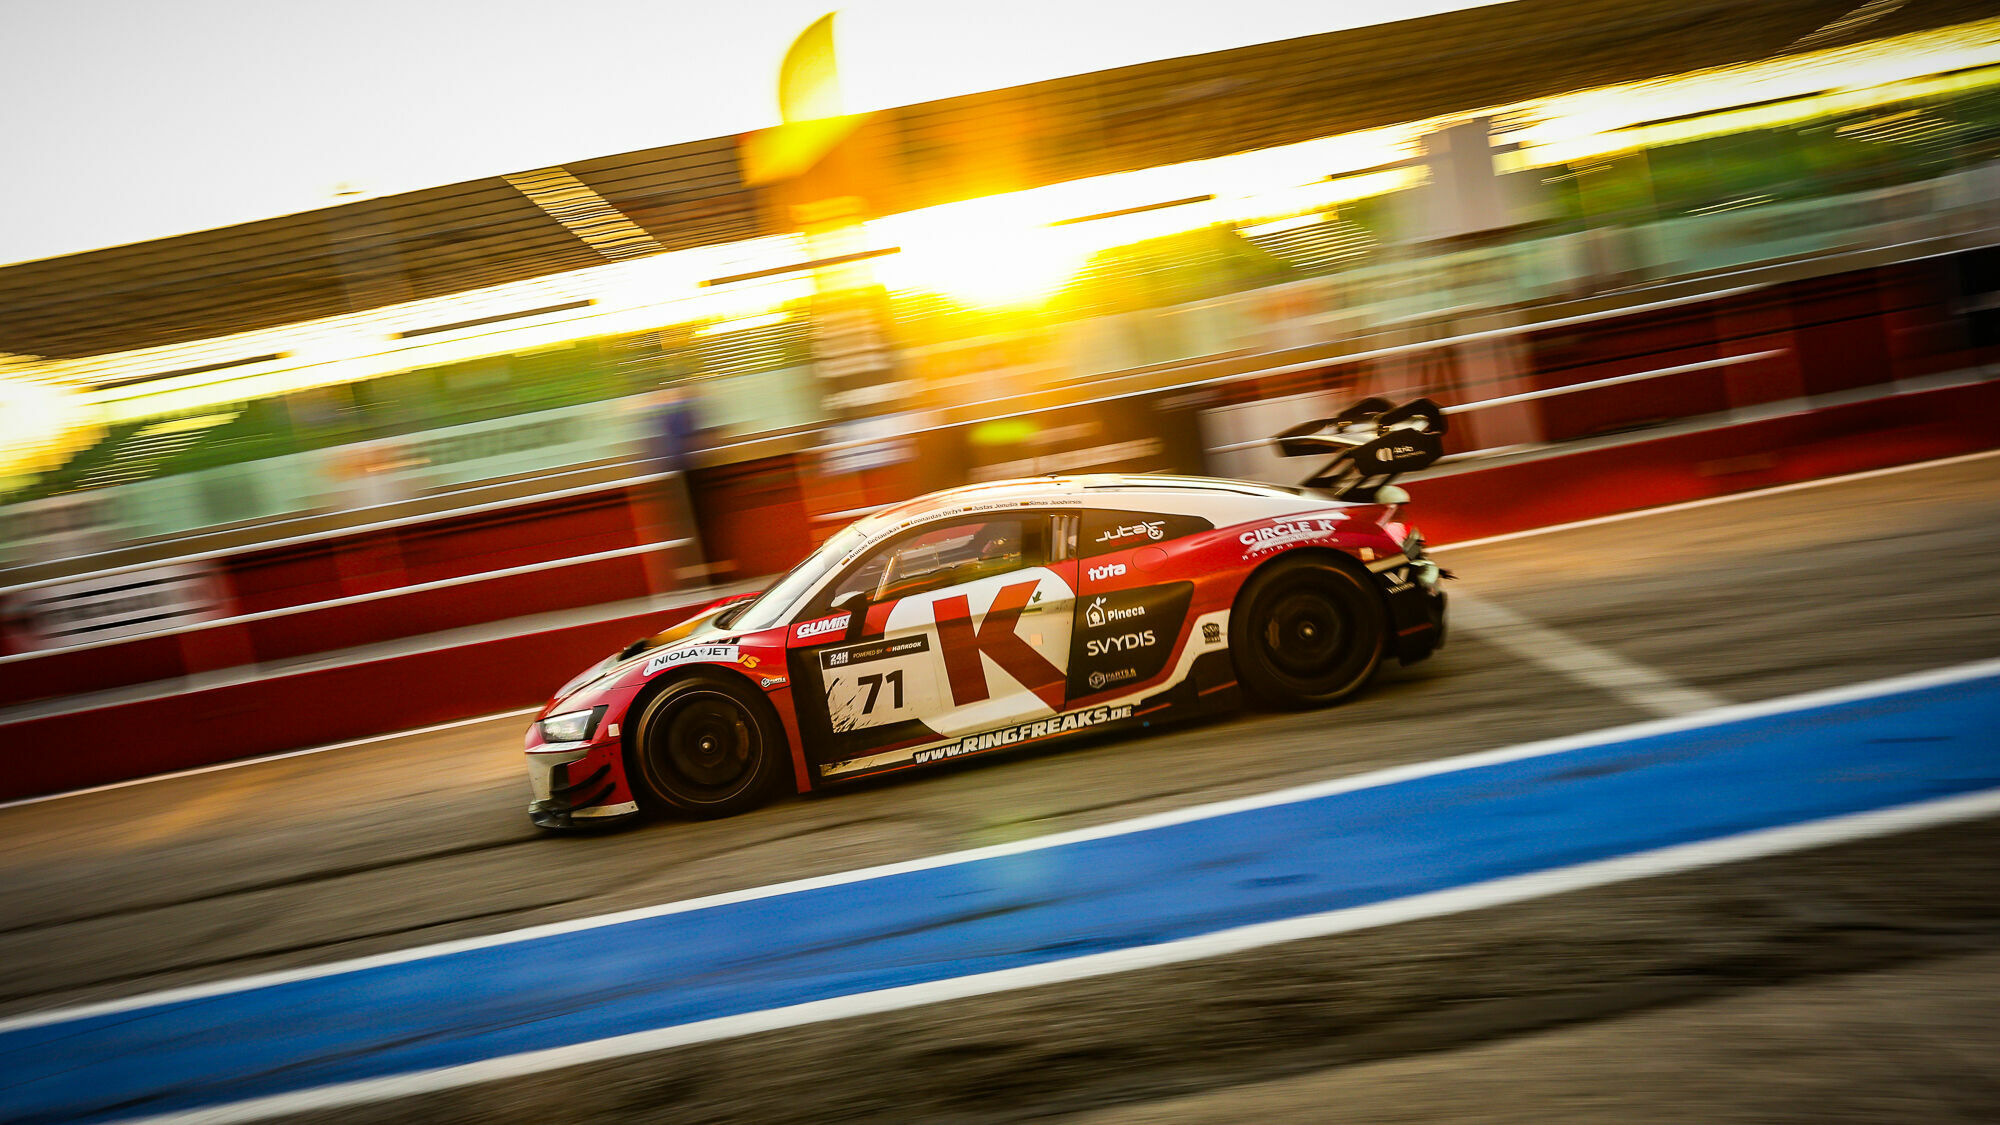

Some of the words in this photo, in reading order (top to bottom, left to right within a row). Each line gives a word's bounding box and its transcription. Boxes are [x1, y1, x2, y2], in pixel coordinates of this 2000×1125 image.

[1239, 521, 1312, 546] CIRCLE
[1318, 520, 1336, 531] K
[1107, 605, 1145, 621] Pineca
[932, 579, 1067, 713] K
[1086, 630, 1156, 656] SVYDIS
[655, 649, 698, 666] NIOLA
[707, 647, 731, 656] JET
[830, 651, 848, 662] 24H
[858, 669, 903, 715] 71
